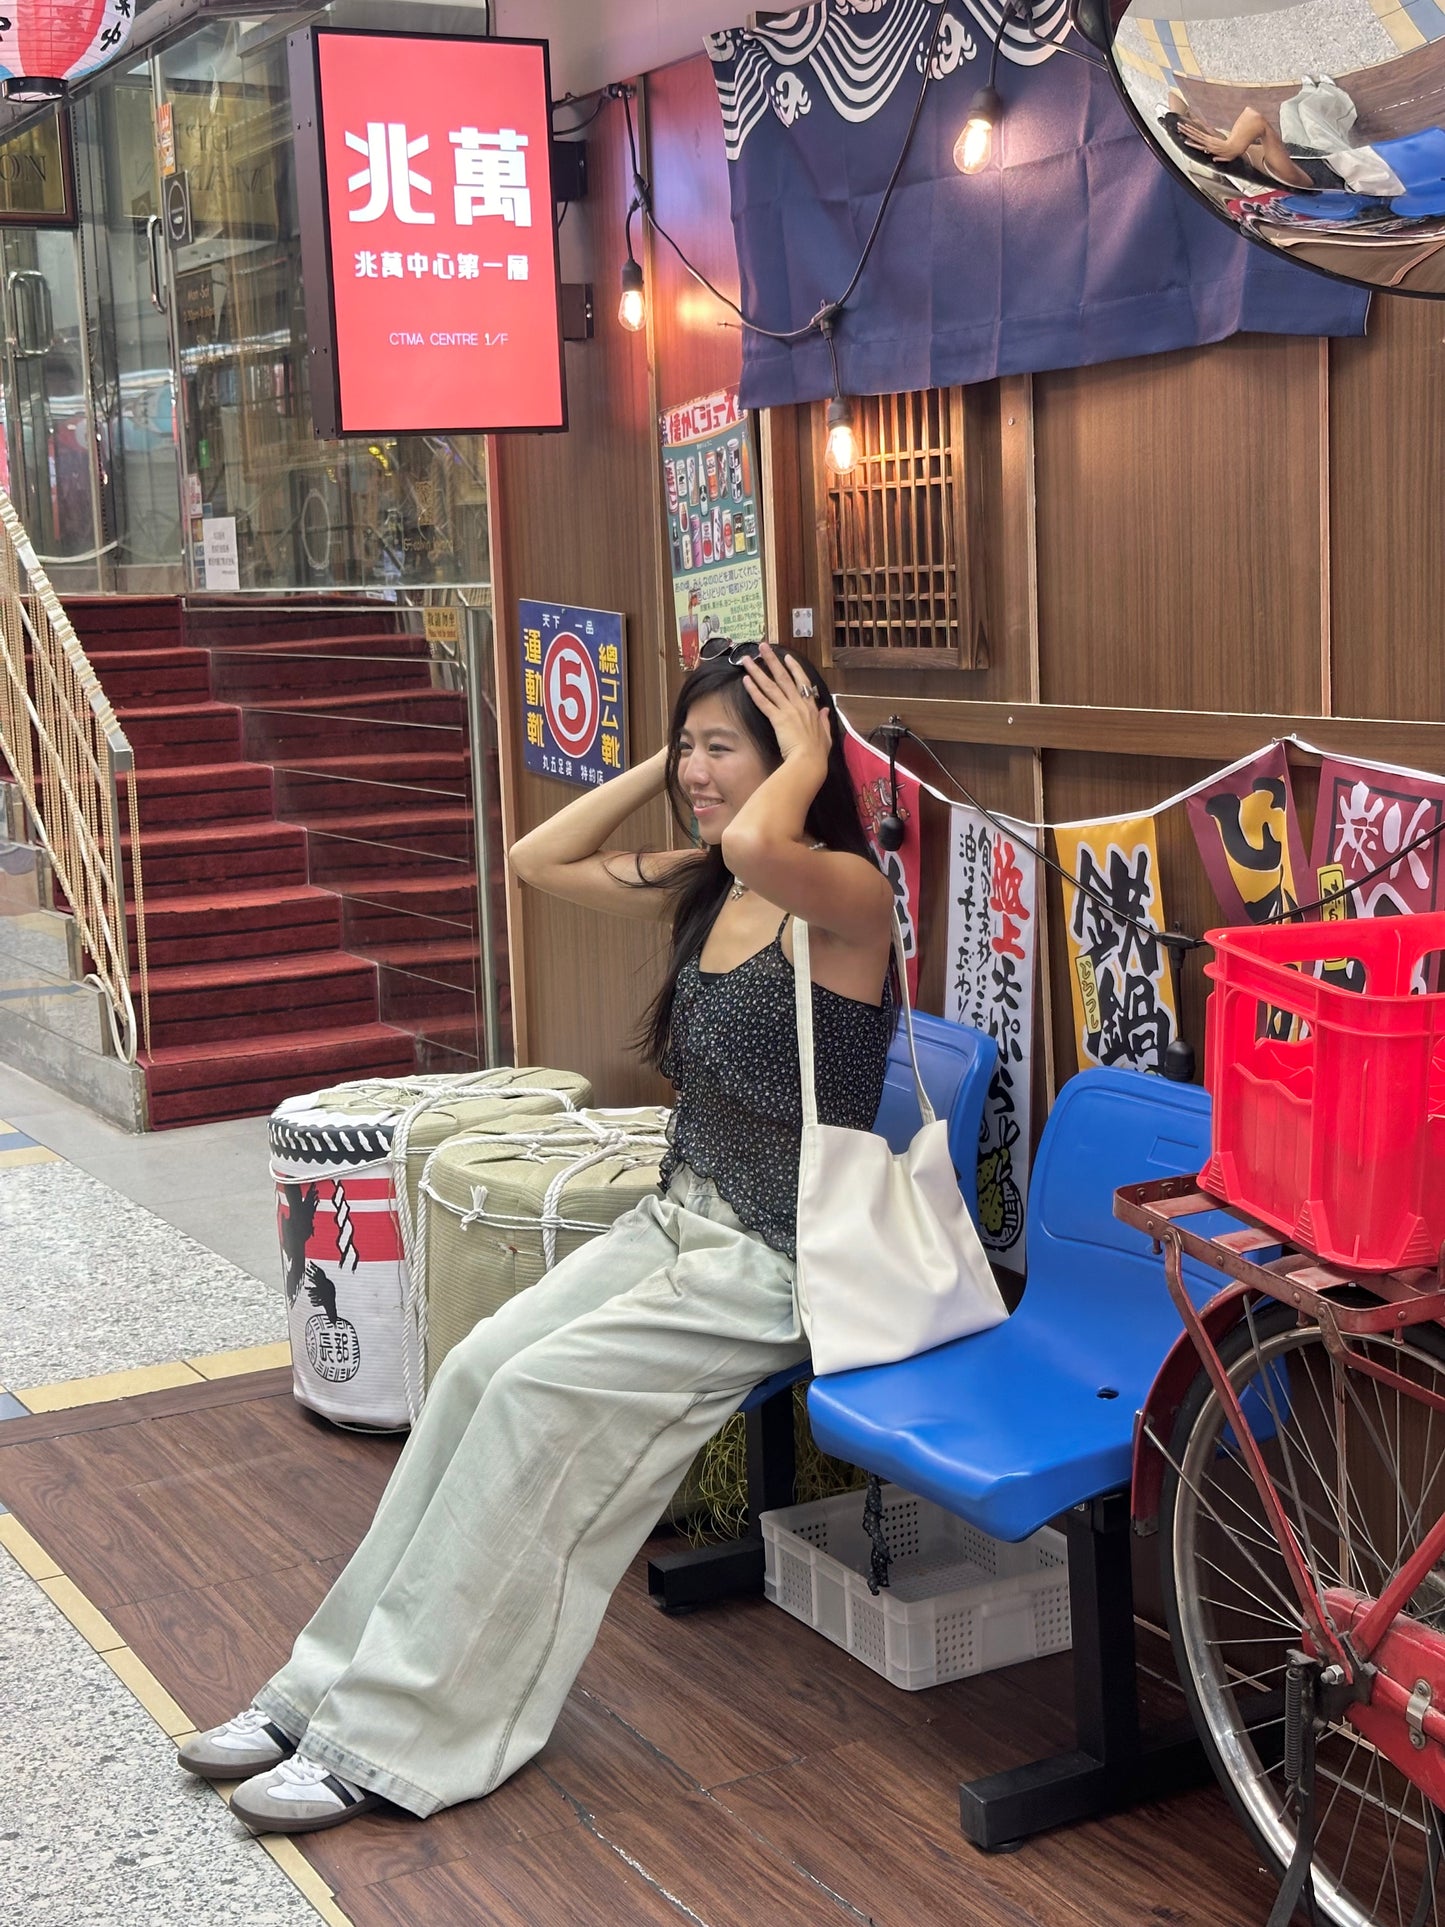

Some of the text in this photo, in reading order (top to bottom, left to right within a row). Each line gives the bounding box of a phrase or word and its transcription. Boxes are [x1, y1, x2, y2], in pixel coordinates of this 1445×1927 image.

[344, 121, 533, 228] 兆萬
[389, 332, 510, 347] CTMA CENTRE 1/F
[542, 613, 595, 636] 天下 一品
[557, 655, 587, 735] 5
[542, 754, 574, 778] 丸五足袋
